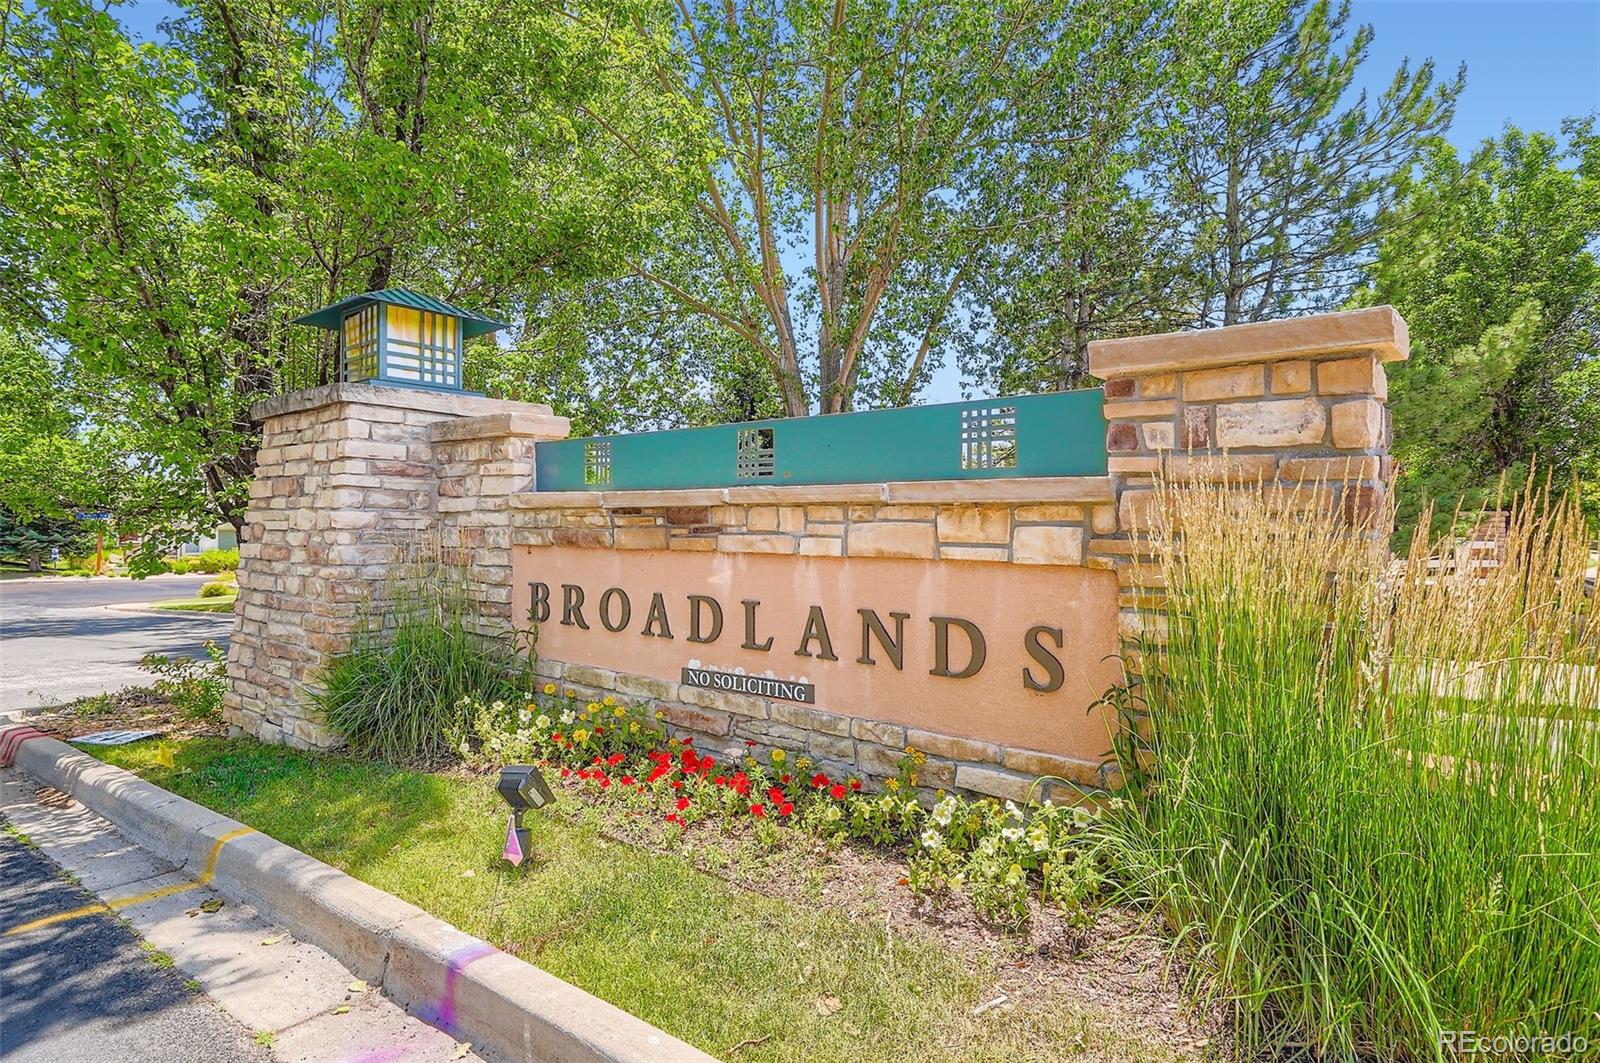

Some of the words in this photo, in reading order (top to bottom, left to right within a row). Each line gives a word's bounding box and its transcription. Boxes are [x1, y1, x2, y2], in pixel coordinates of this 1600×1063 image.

[526, 581, 1067, 693] BROADLANDS
[688, 670, 710, 686] NO
[714, 673, 806, 701] SOLICITING
